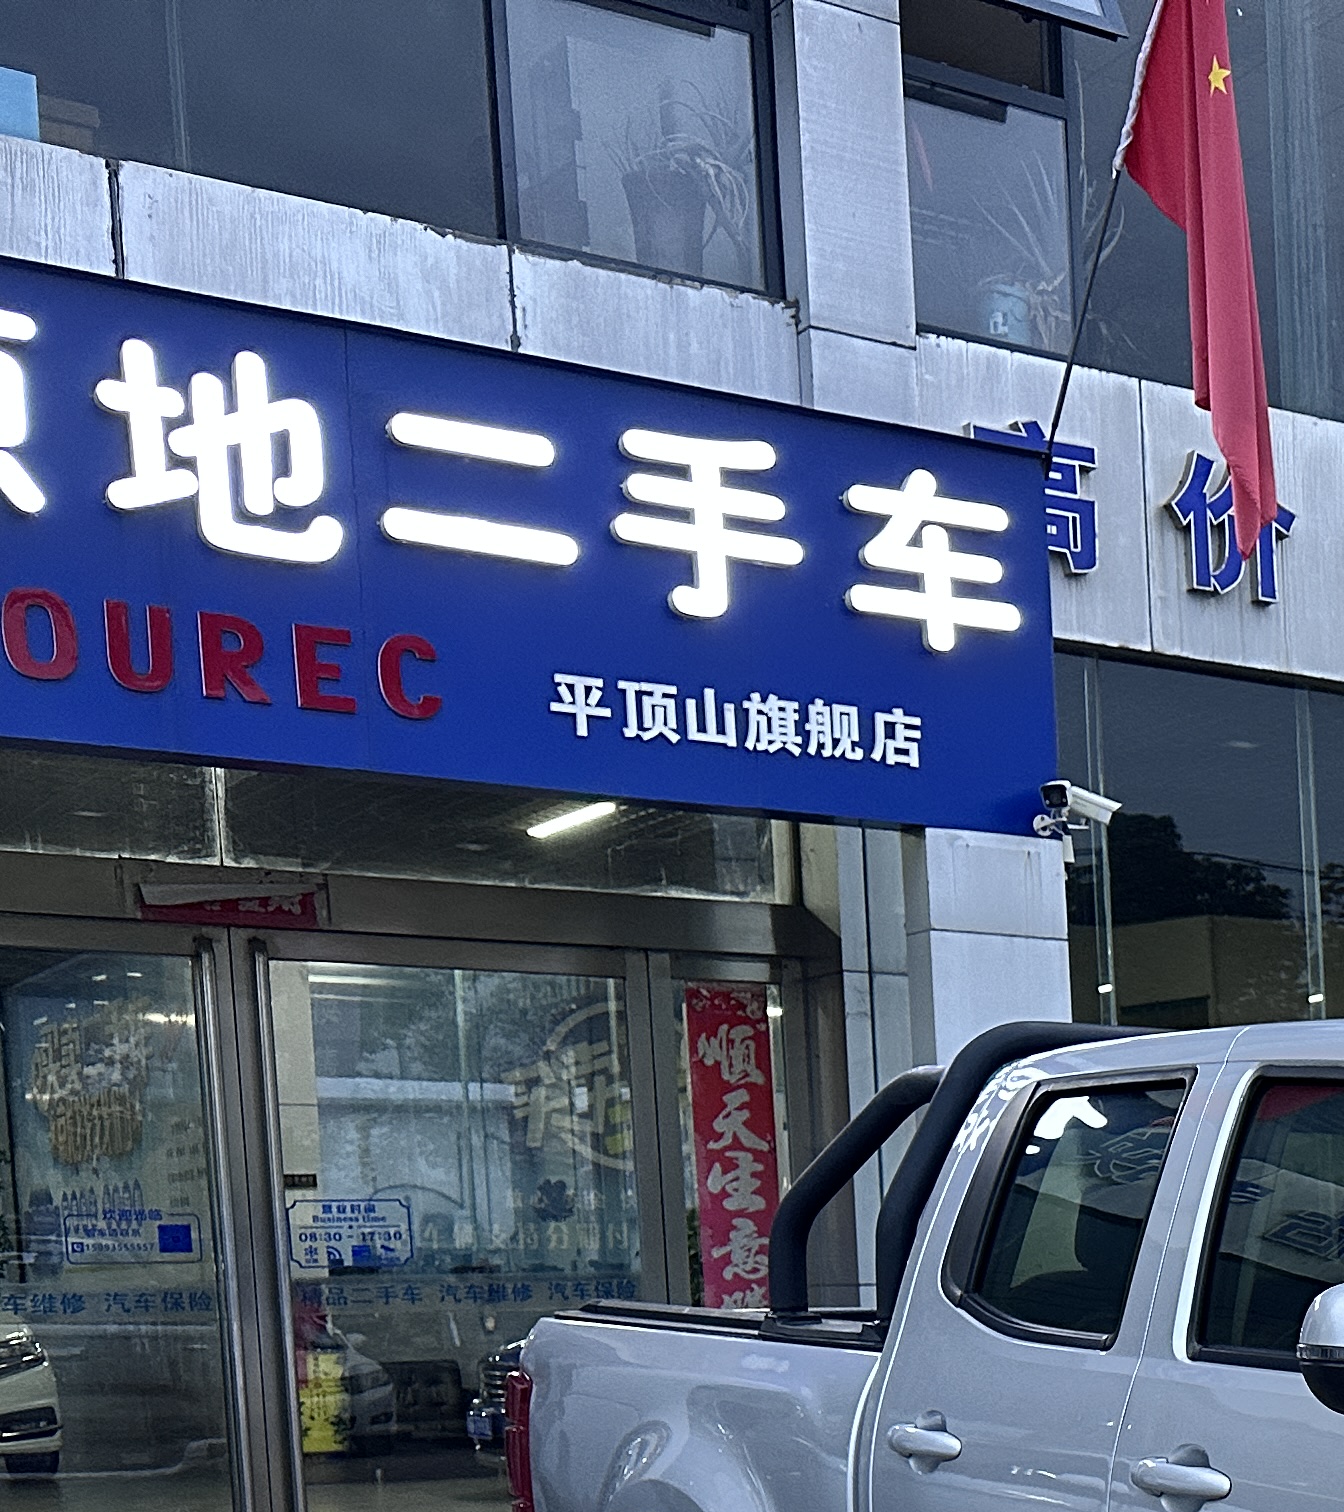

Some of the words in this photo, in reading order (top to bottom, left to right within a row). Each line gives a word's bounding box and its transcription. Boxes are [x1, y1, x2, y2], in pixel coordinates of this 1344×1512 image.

[2, 585, 444, 721] OUREC
[549, 672, 923, 769] 平顶山旗舰店
[102, 1208, 163, 1221] 欢迎光临
[104, 1290, 214, 1314] 汽车保险
